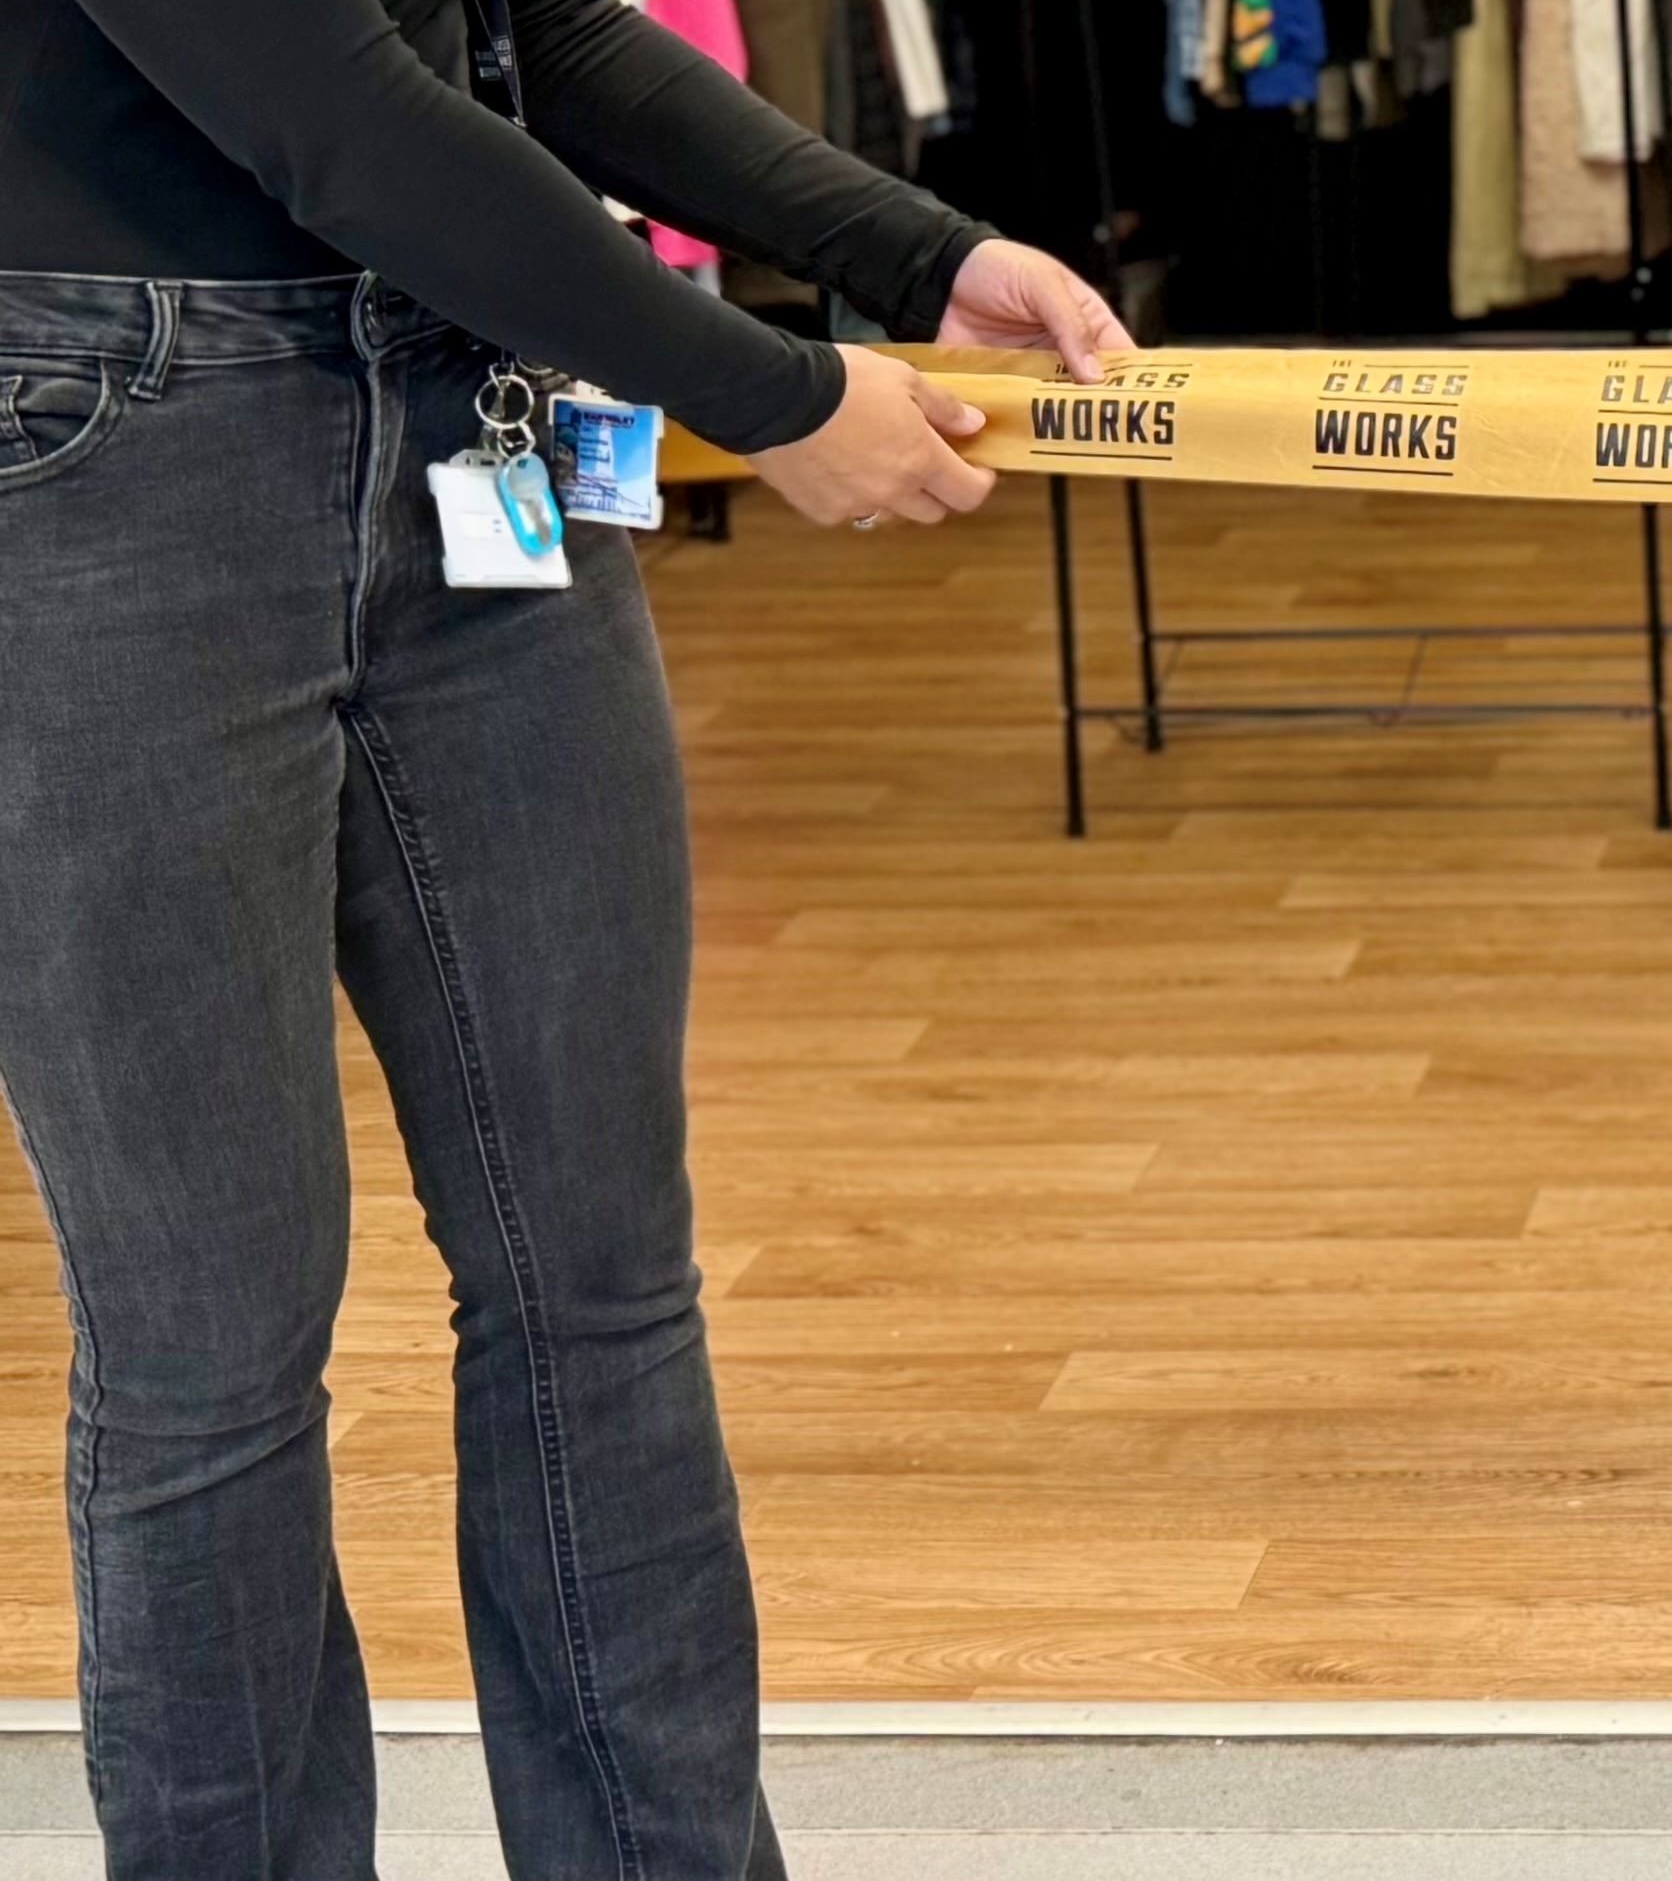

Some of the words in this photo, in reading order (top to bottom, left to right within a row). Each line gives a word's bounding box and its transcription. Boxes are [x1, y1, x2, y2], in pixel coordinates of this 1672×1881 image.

[1323, 373, 1468, 396] GLASS
[1031, 397, 1175, 445] WORKS
[1315, 409, 1457, 460] WORKS
